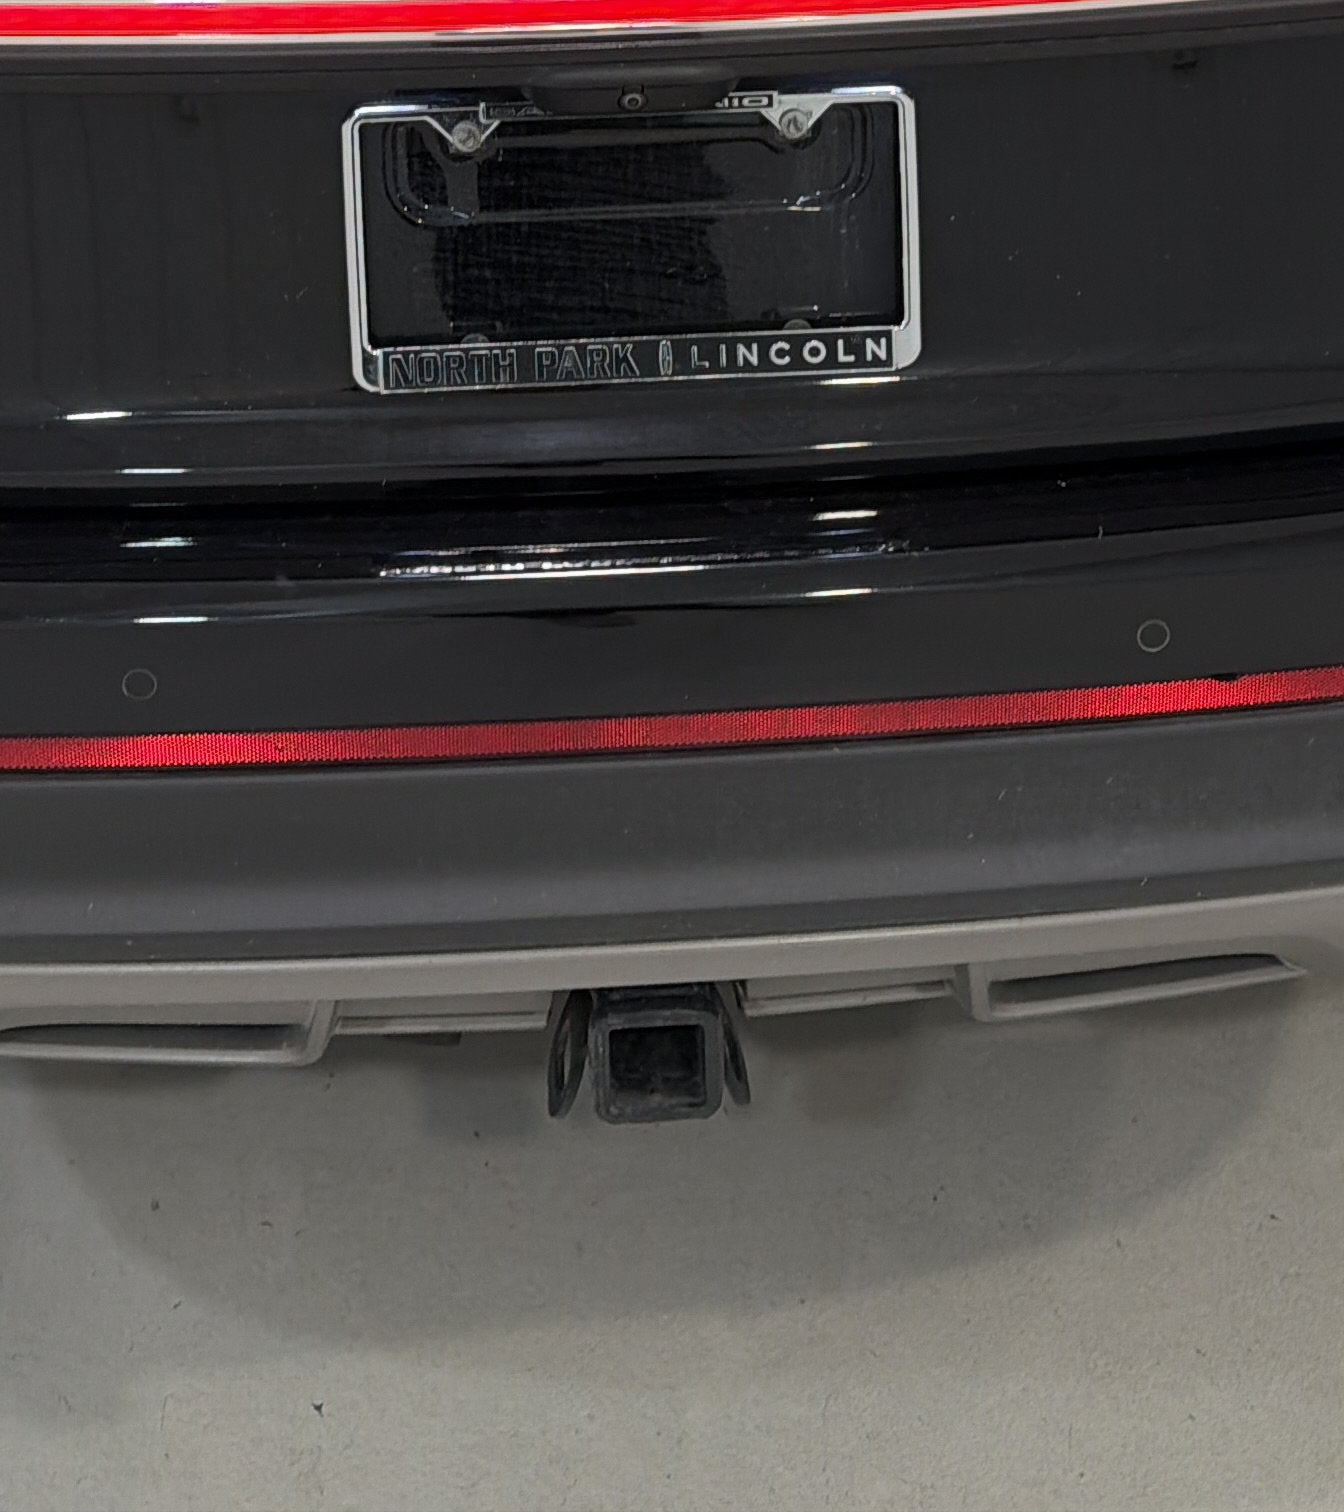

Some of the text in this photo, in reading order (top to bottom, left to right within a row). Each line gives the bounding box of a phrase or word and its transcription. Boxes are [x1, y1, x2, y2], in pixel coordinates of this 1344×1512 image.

[389, 336, 888, 388] NORTH PARK LINCOLN
